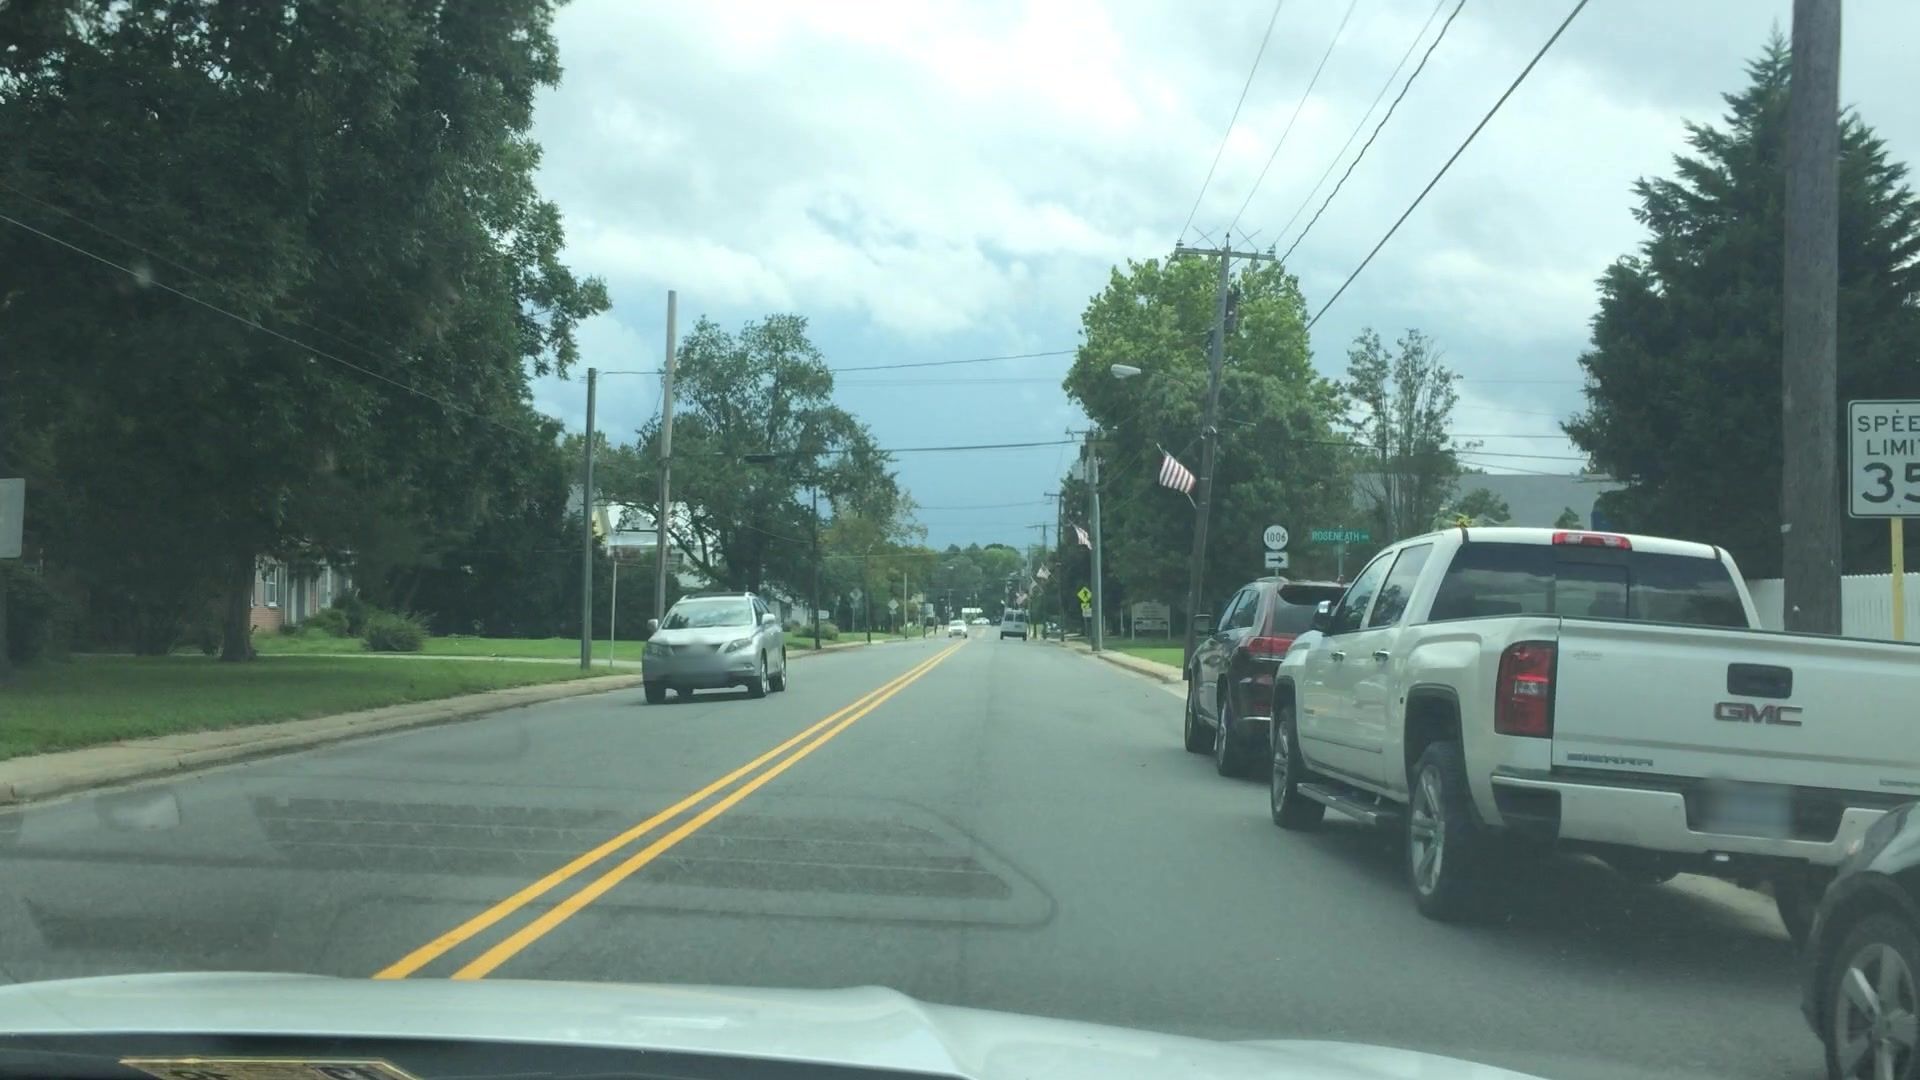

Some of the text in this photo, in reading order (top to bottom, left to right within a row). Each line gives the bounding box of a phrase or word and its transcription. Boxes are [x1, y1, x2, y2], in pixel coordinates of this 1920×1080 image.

[1867, 439, 1920, 456] LIMI
[1266, 532, 1287, 543] 1006
[1311, 531, 1360, 542] ROSENEATH
[1714, 702, 1803, 726] GMC
